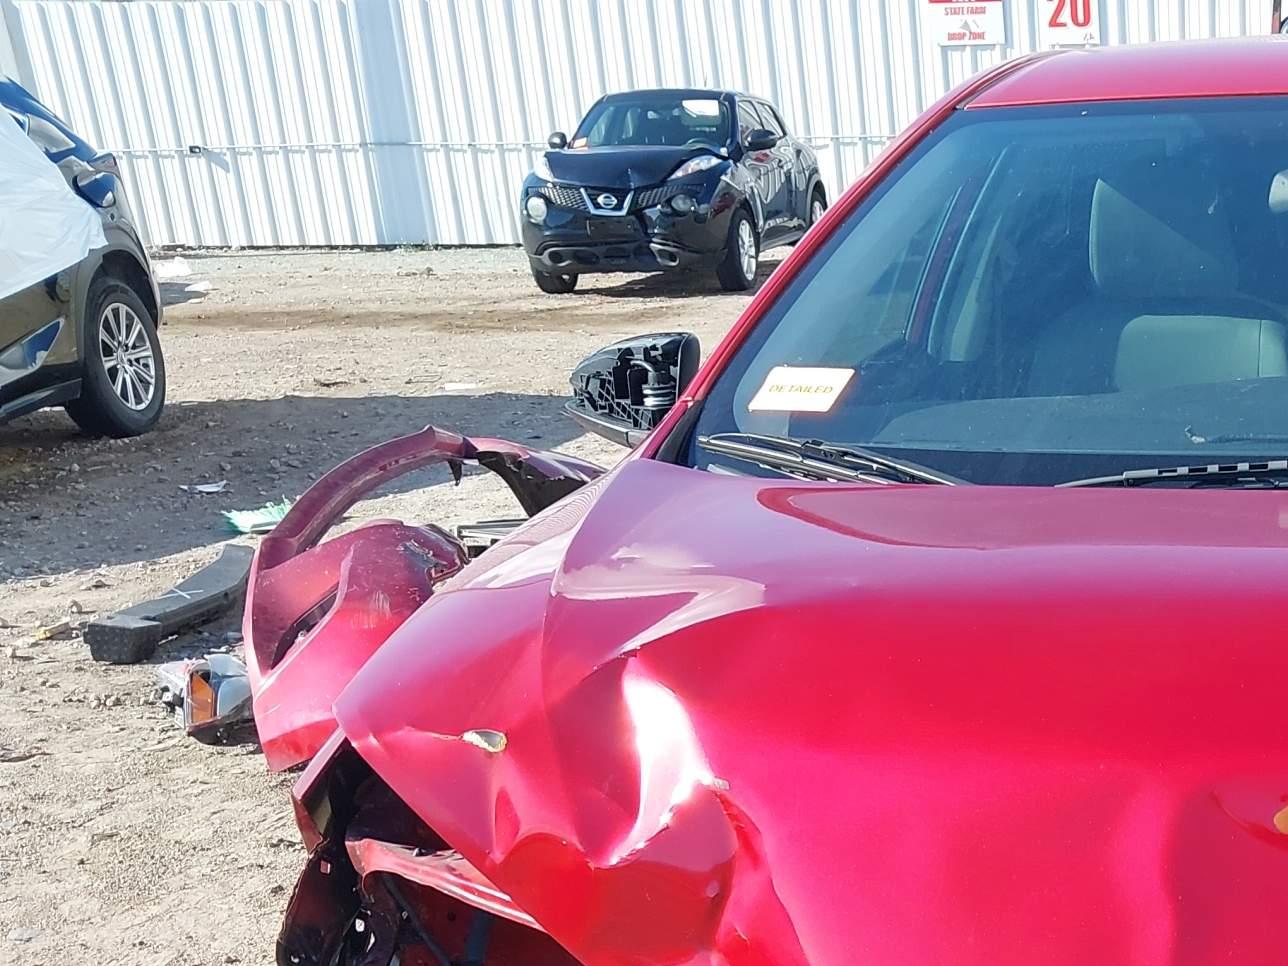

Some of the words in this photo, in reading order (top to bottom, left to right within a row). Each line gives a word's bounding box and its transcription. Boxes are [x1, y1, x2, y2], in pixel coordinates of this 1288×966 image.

[944, 7, 965, 16] STATE
[966, 6, 986, 15] FARM
[1049, 0, 1091, 28] 20
[947, 32, 967, 41] DROP
[968, 32, 986, 41] ZONE
[768, 385, 834, 393] DETAILED
